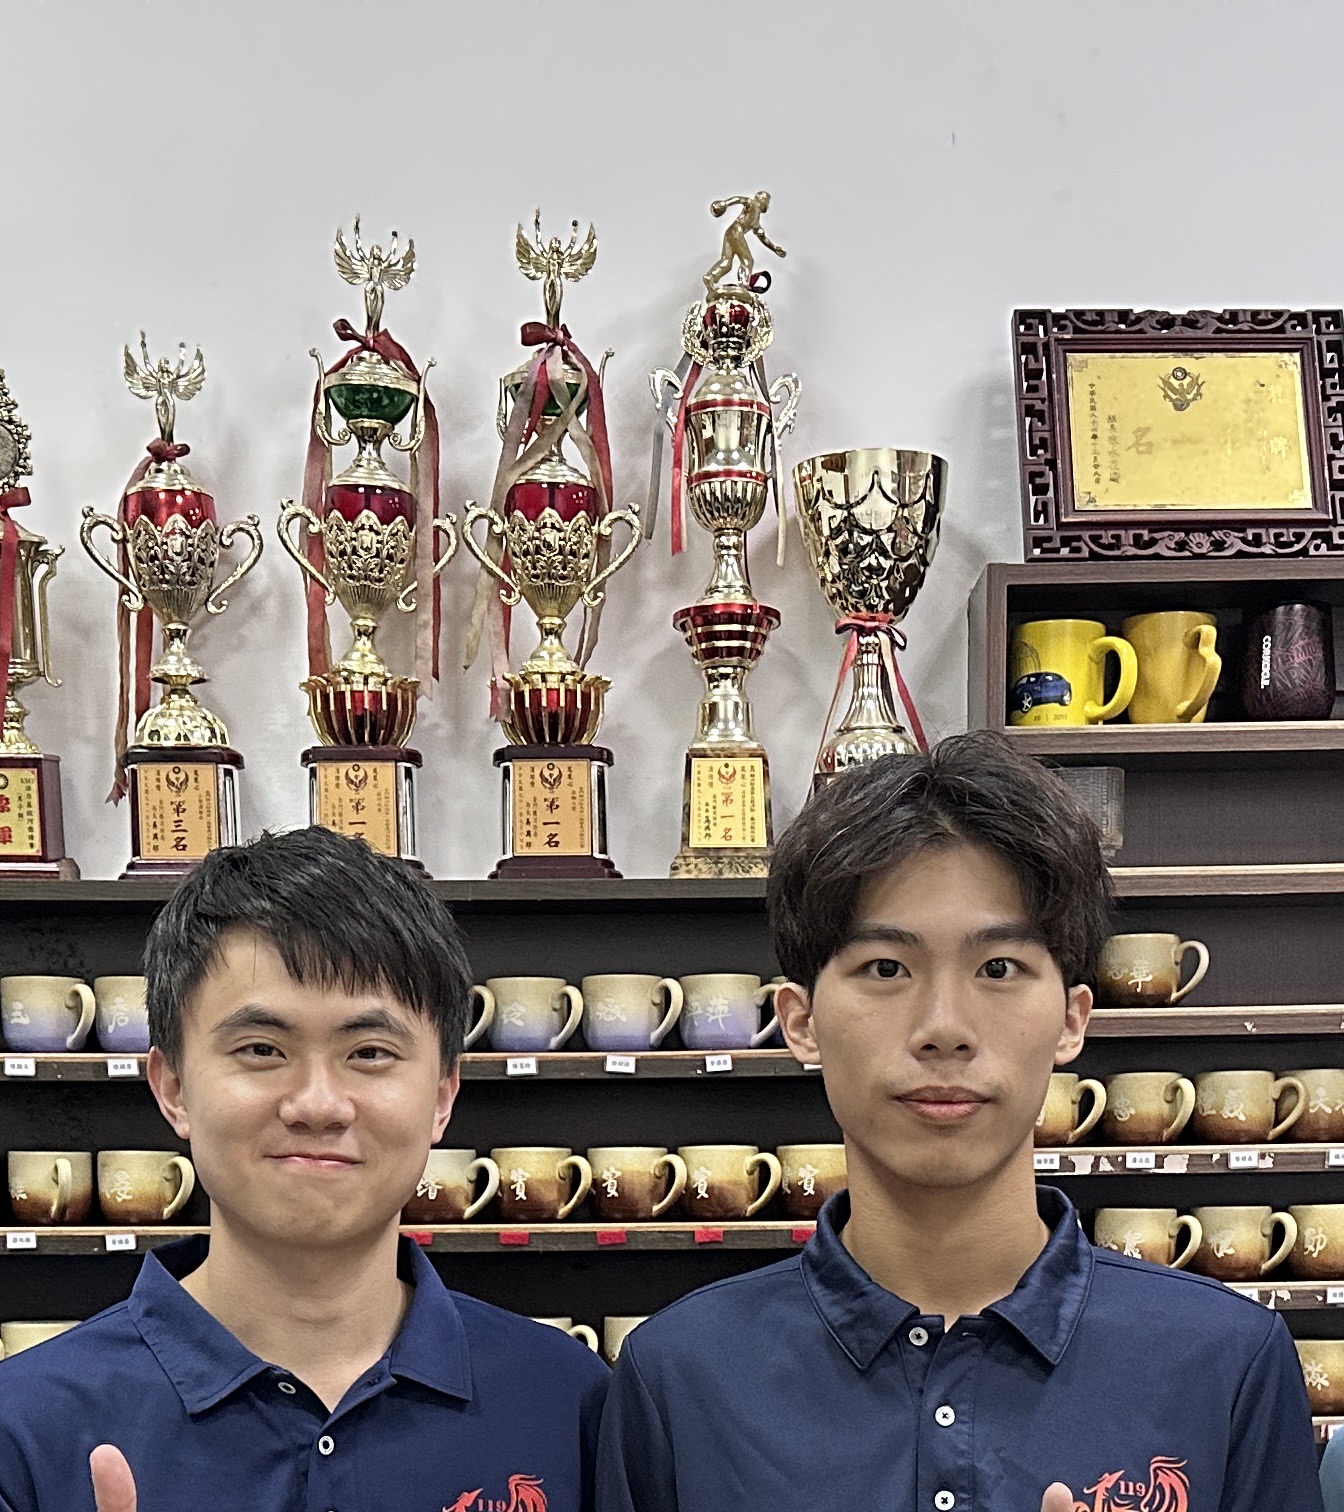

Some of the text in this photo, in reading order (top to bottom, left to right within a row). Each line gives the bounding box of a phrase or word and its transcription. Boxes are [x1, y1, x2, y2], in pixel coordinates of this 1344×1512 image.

[170, 800, 188, 851] 第三名
[542, 796, 561, 848] 第一名
[720, 791, 735, 841] 第一名
[476, 1497, 506, 1512] 119
[1117, 1479, 1147, 1497] 119
